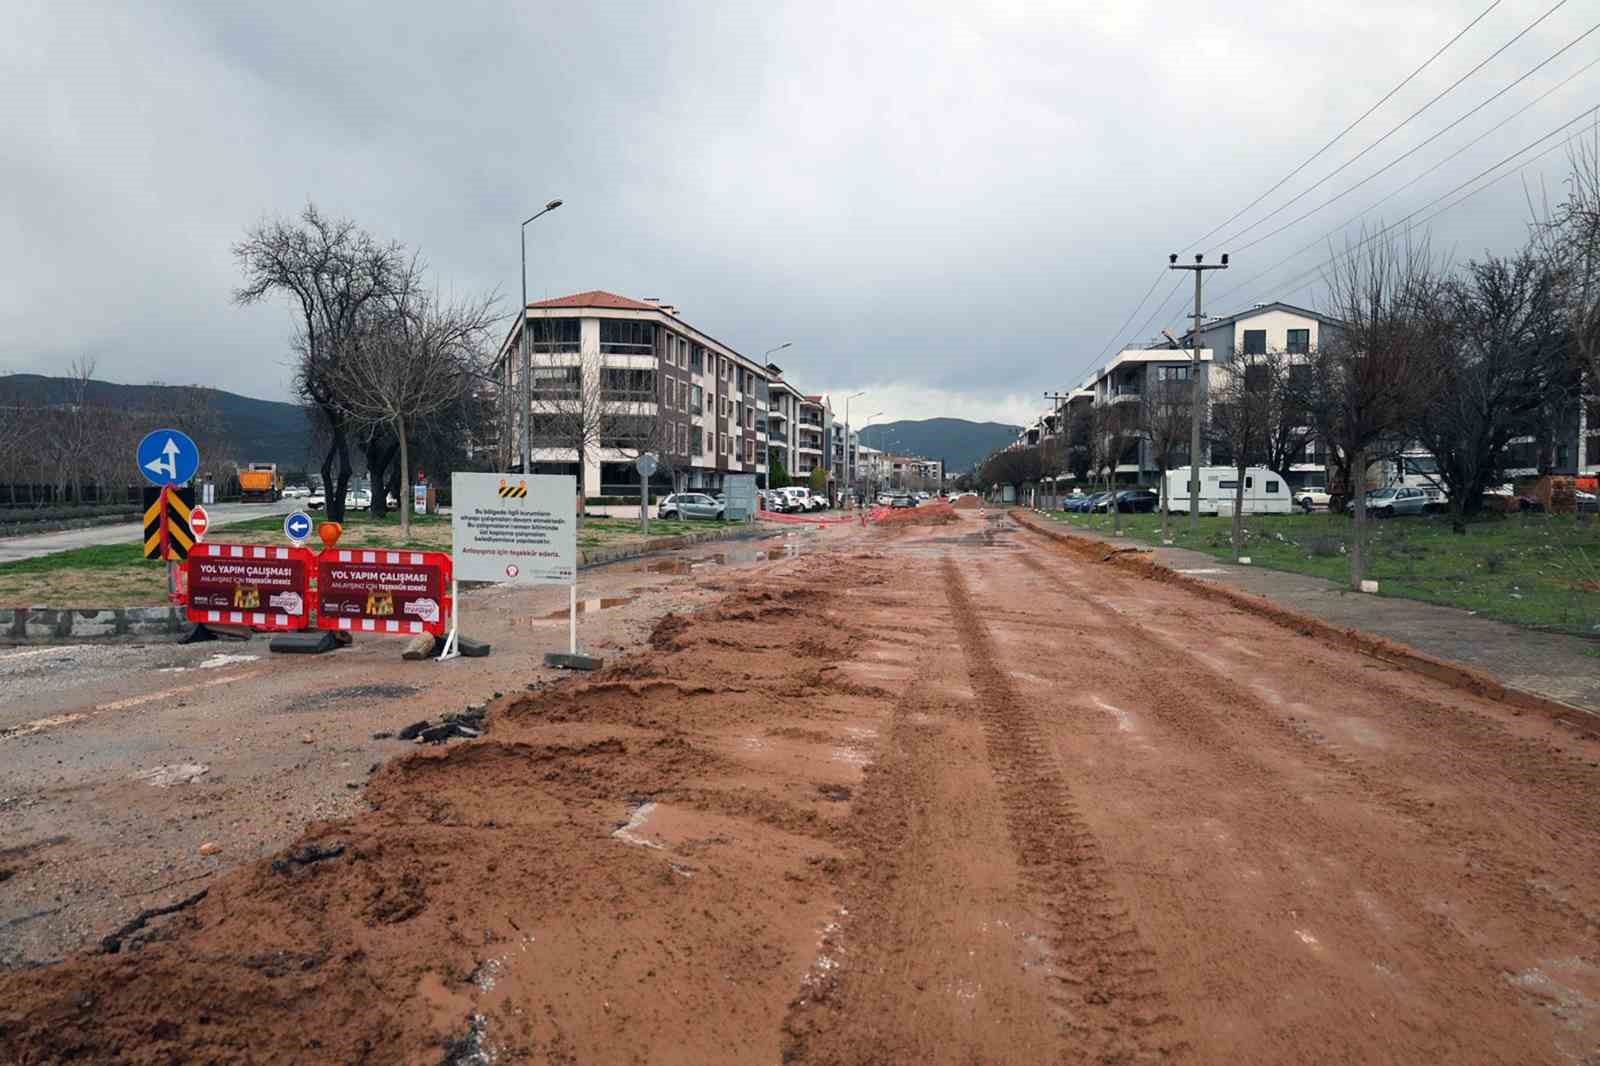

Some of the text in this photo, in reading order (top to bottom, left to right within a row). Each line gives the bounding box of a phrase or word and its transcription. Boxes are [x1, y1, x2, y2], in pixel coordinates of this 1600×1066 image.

[497, 548, 508, 556] için
[510, 549, 537, 557] teşekkür
[200, 565, 292, 577] YOL YAPIM ÇALIŞMASI
[331, 571, 427, 582] YOL YAPIM ÇALIŞMASI
